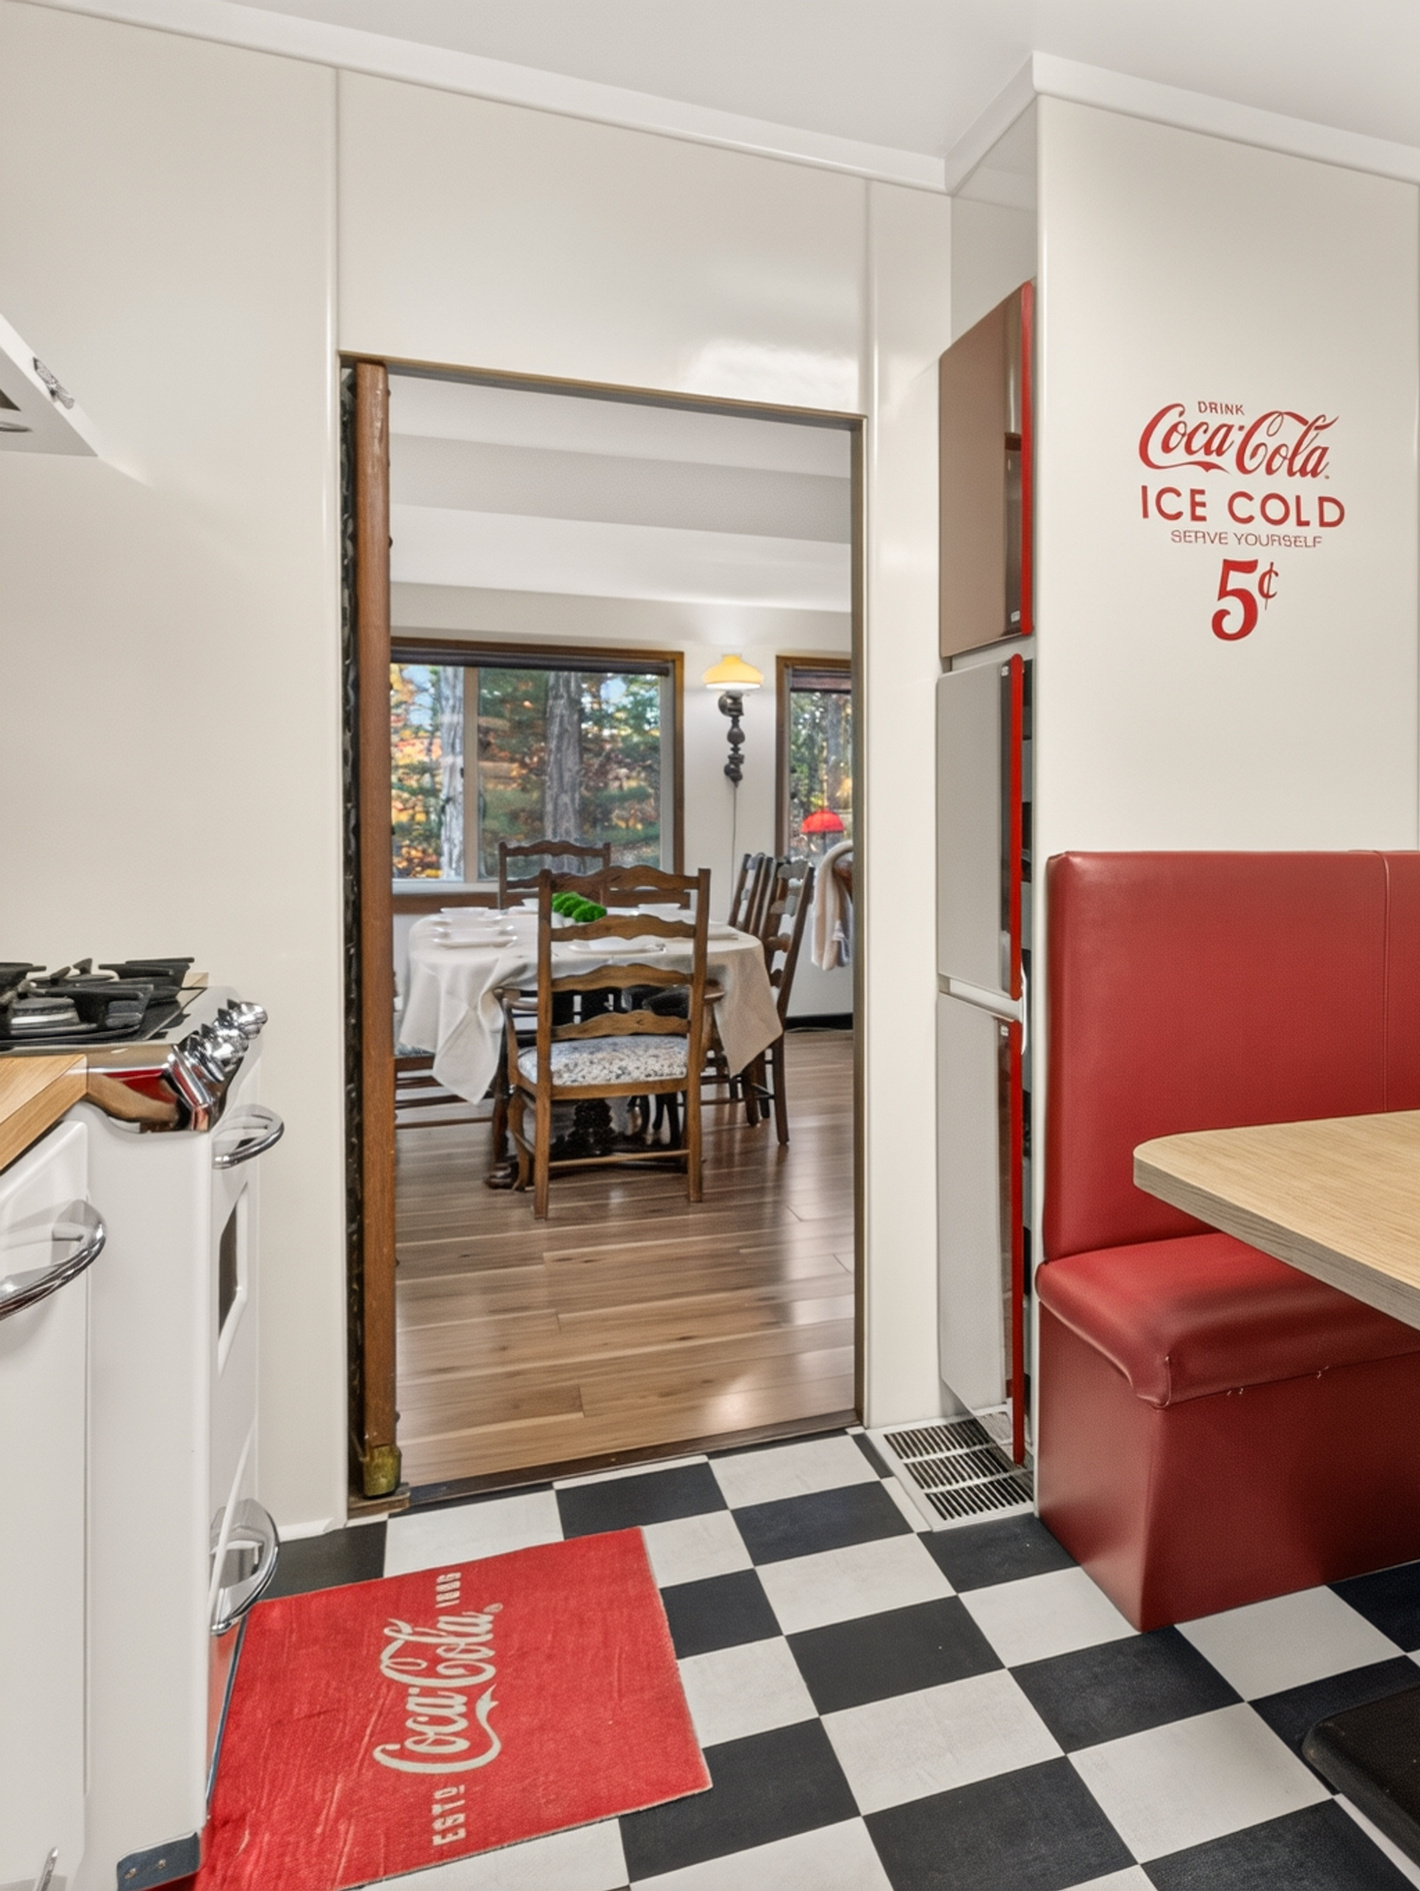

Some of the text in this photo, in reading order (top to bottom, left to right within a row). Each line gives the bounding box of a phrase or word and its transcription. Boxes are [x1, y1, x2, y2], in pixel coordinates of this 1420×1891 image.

[1197, 400, 1245, 416] DRINK
[1140, 484, 1346, 528] ICE COLD
[1170, 529, 1323, 549] SERVE YOURSELF
